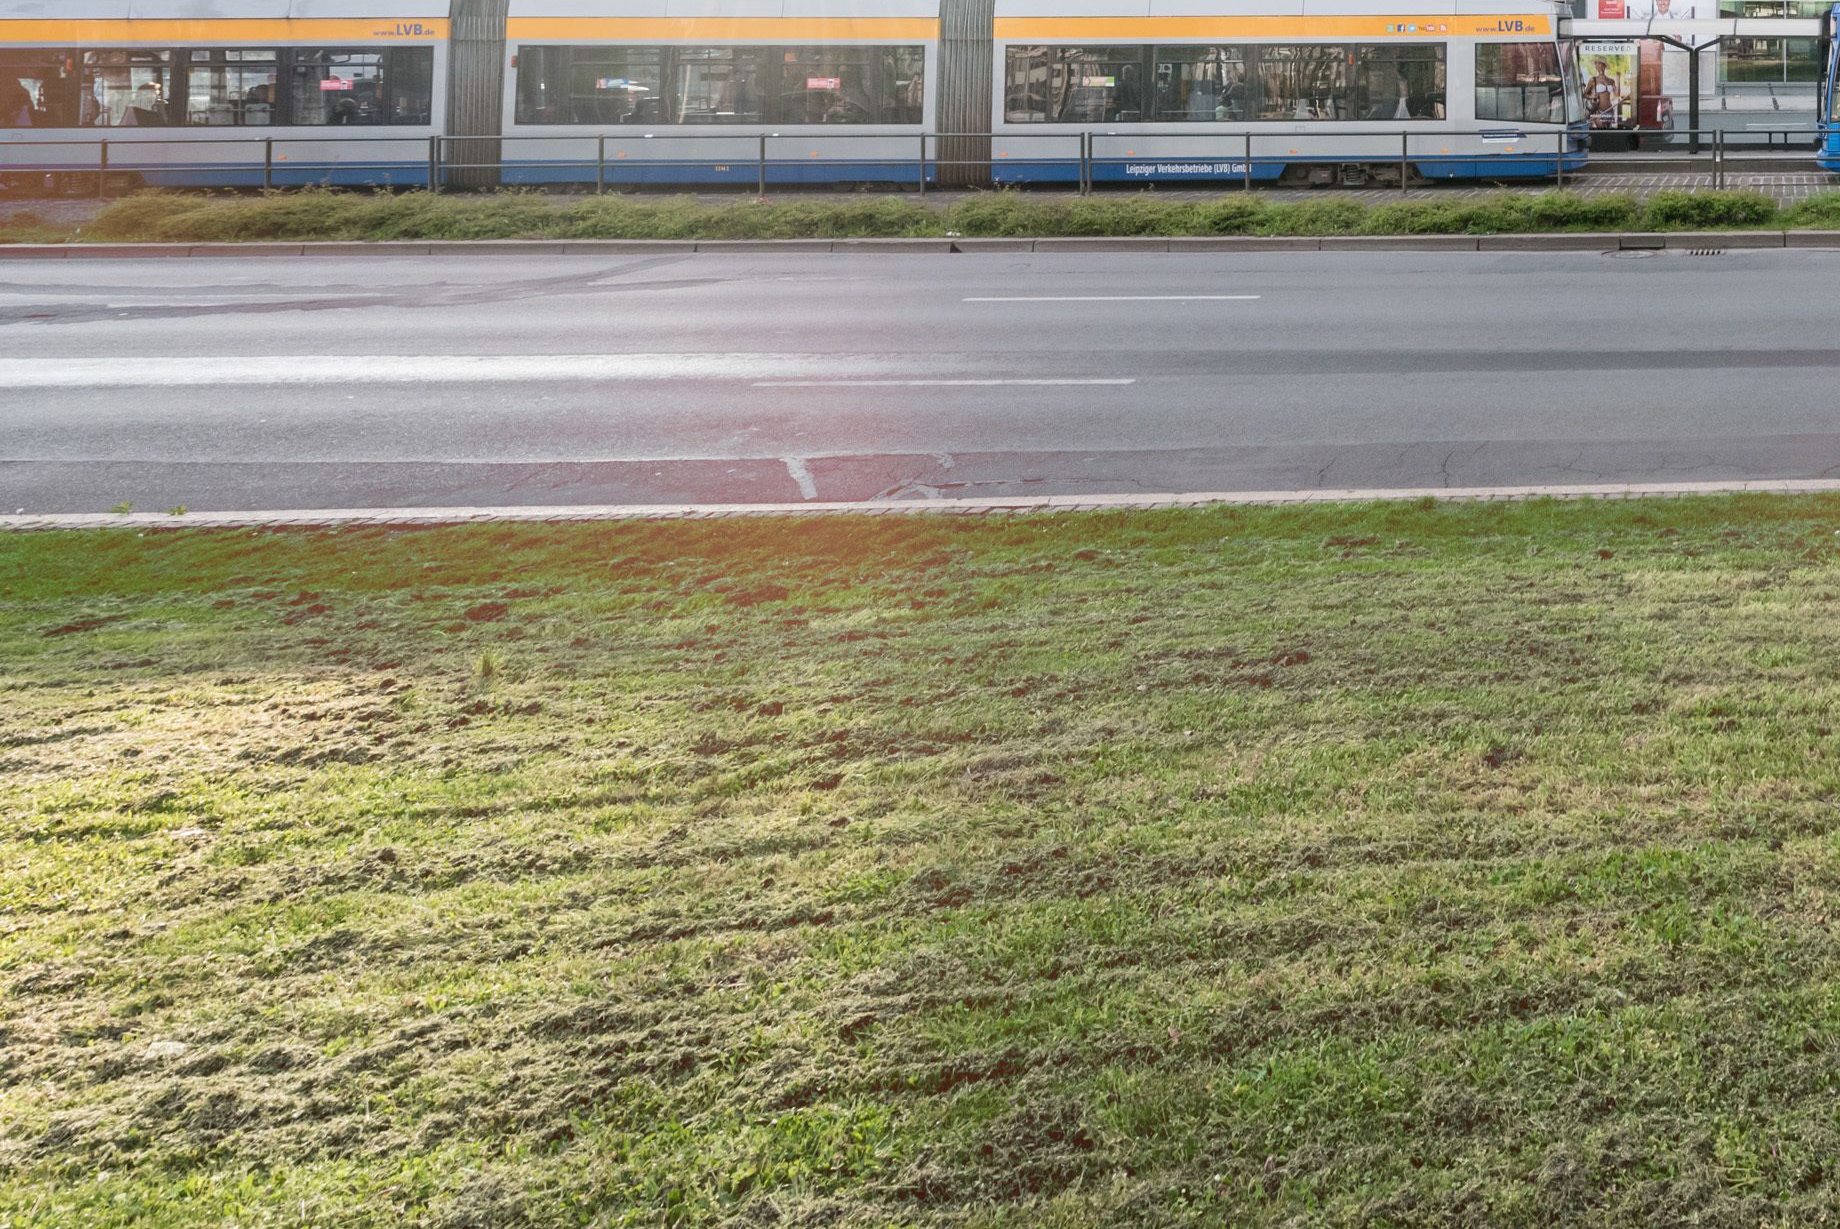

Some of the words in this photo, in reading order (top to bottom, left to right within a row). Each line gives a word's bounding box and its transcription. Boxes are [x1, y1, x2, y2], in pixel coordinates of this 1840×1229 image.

[373, 23, 436, 36] www.LVB.de
[1475, 20, 1535, 33] www.LVB.de
[1126, 163, 1156, 176] Leipziger
[1157, 163, 1213, 174] Verkehrsbetriebe
[1214, 163, 1230, 175] (LVB)
